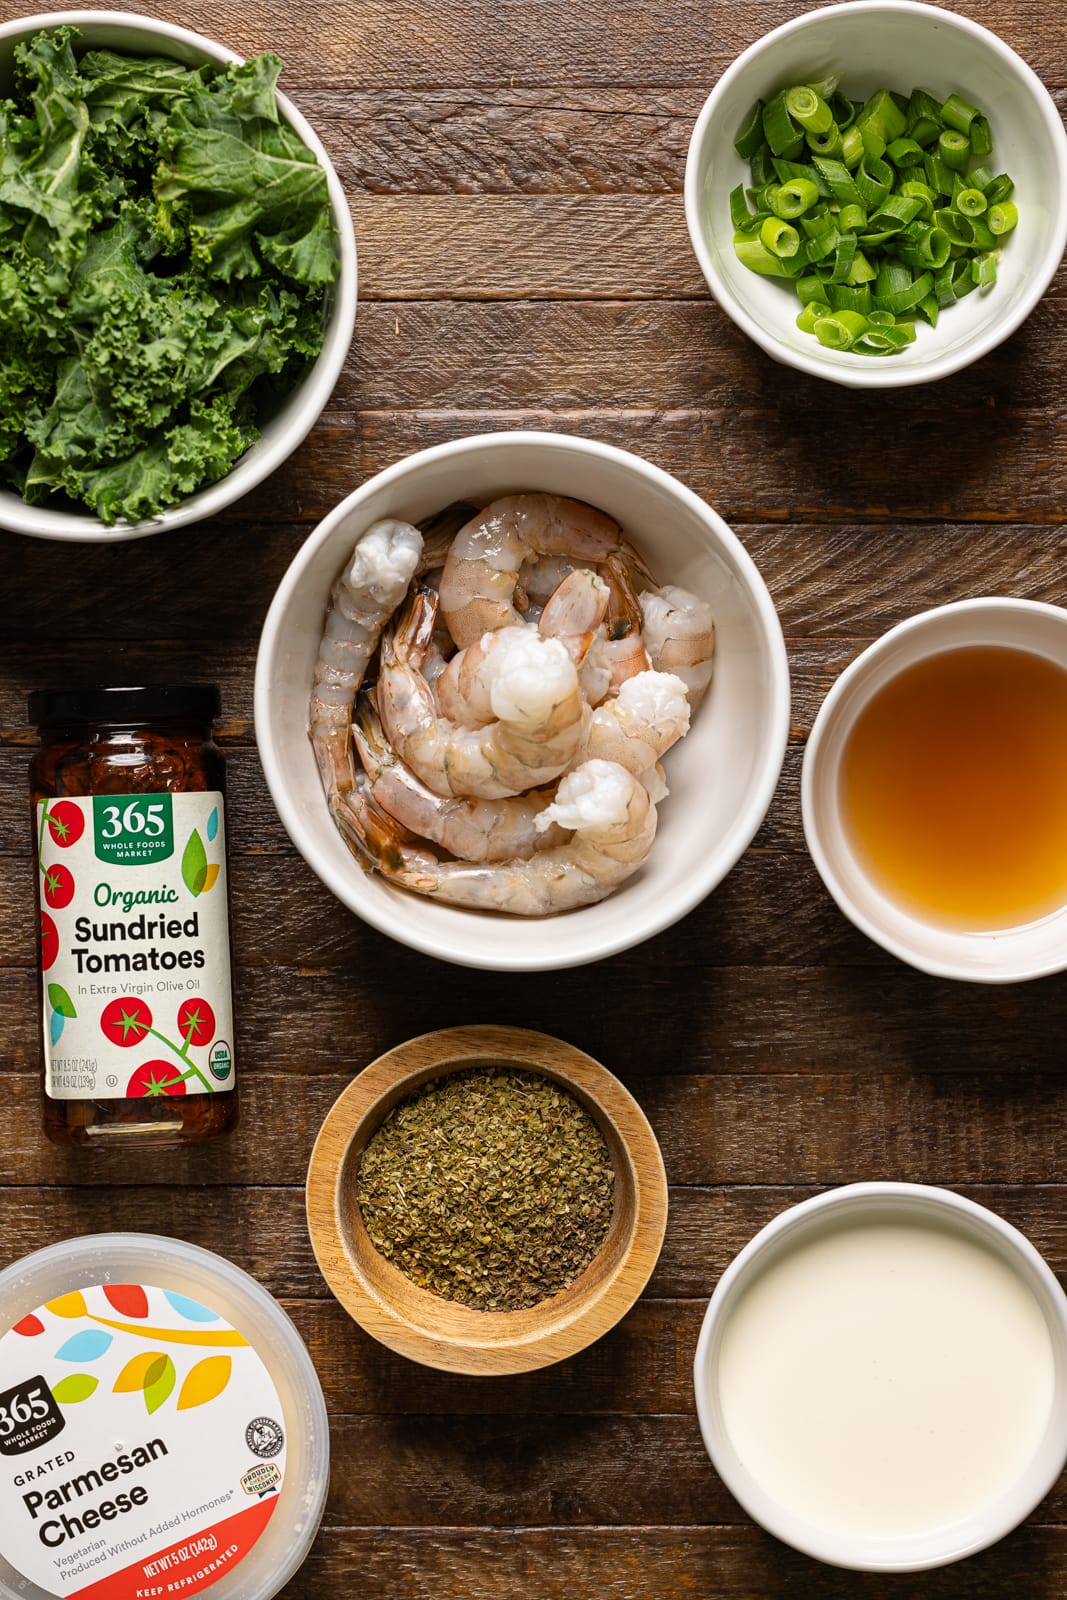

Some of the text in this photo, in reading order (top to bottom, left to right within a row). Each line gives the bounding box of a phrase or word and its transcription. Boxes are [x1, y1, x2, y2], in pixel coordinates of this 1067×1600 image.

[102, 801, 165, 838] 365
[102, 841, 166, 850] WHOLE FOODS
[116, 849, 153, 858] MARKET
[94, 882, 179, 913] Organic
[75, 911, 199, 943] Sundried
[71, 947, 205, 974] Tomatoes
[78, 979, 200, 995] In Extra Virgin Olive Oil
[0, 1387, 49, 1436] 365
[3, 1417, 57, 1447] WHOLE FOODS
[18, 1429, 49, 1448] MARKET
[13, 1451, 76, 1487] GRATED
[22, 1438, 169, 1520] Parmesan
[243, 1466, 275, 1484] PROUDLY
[246, 1473, 279, 1493] WISCONSIN
[39, 1486, 149, 1547] Cheese
[53, 1538, 107, 1568] Vegetarian
[59, 1551, 108, 1581] Produced
[106, 1534, 148, 1558] Without
[149, 1517, 181, 1538] Added
[142, 1533, 218, 1579] NET WT 5 OZ (142g)
[136, 1544, 239, 1598] KEEP REFRIGERATED
